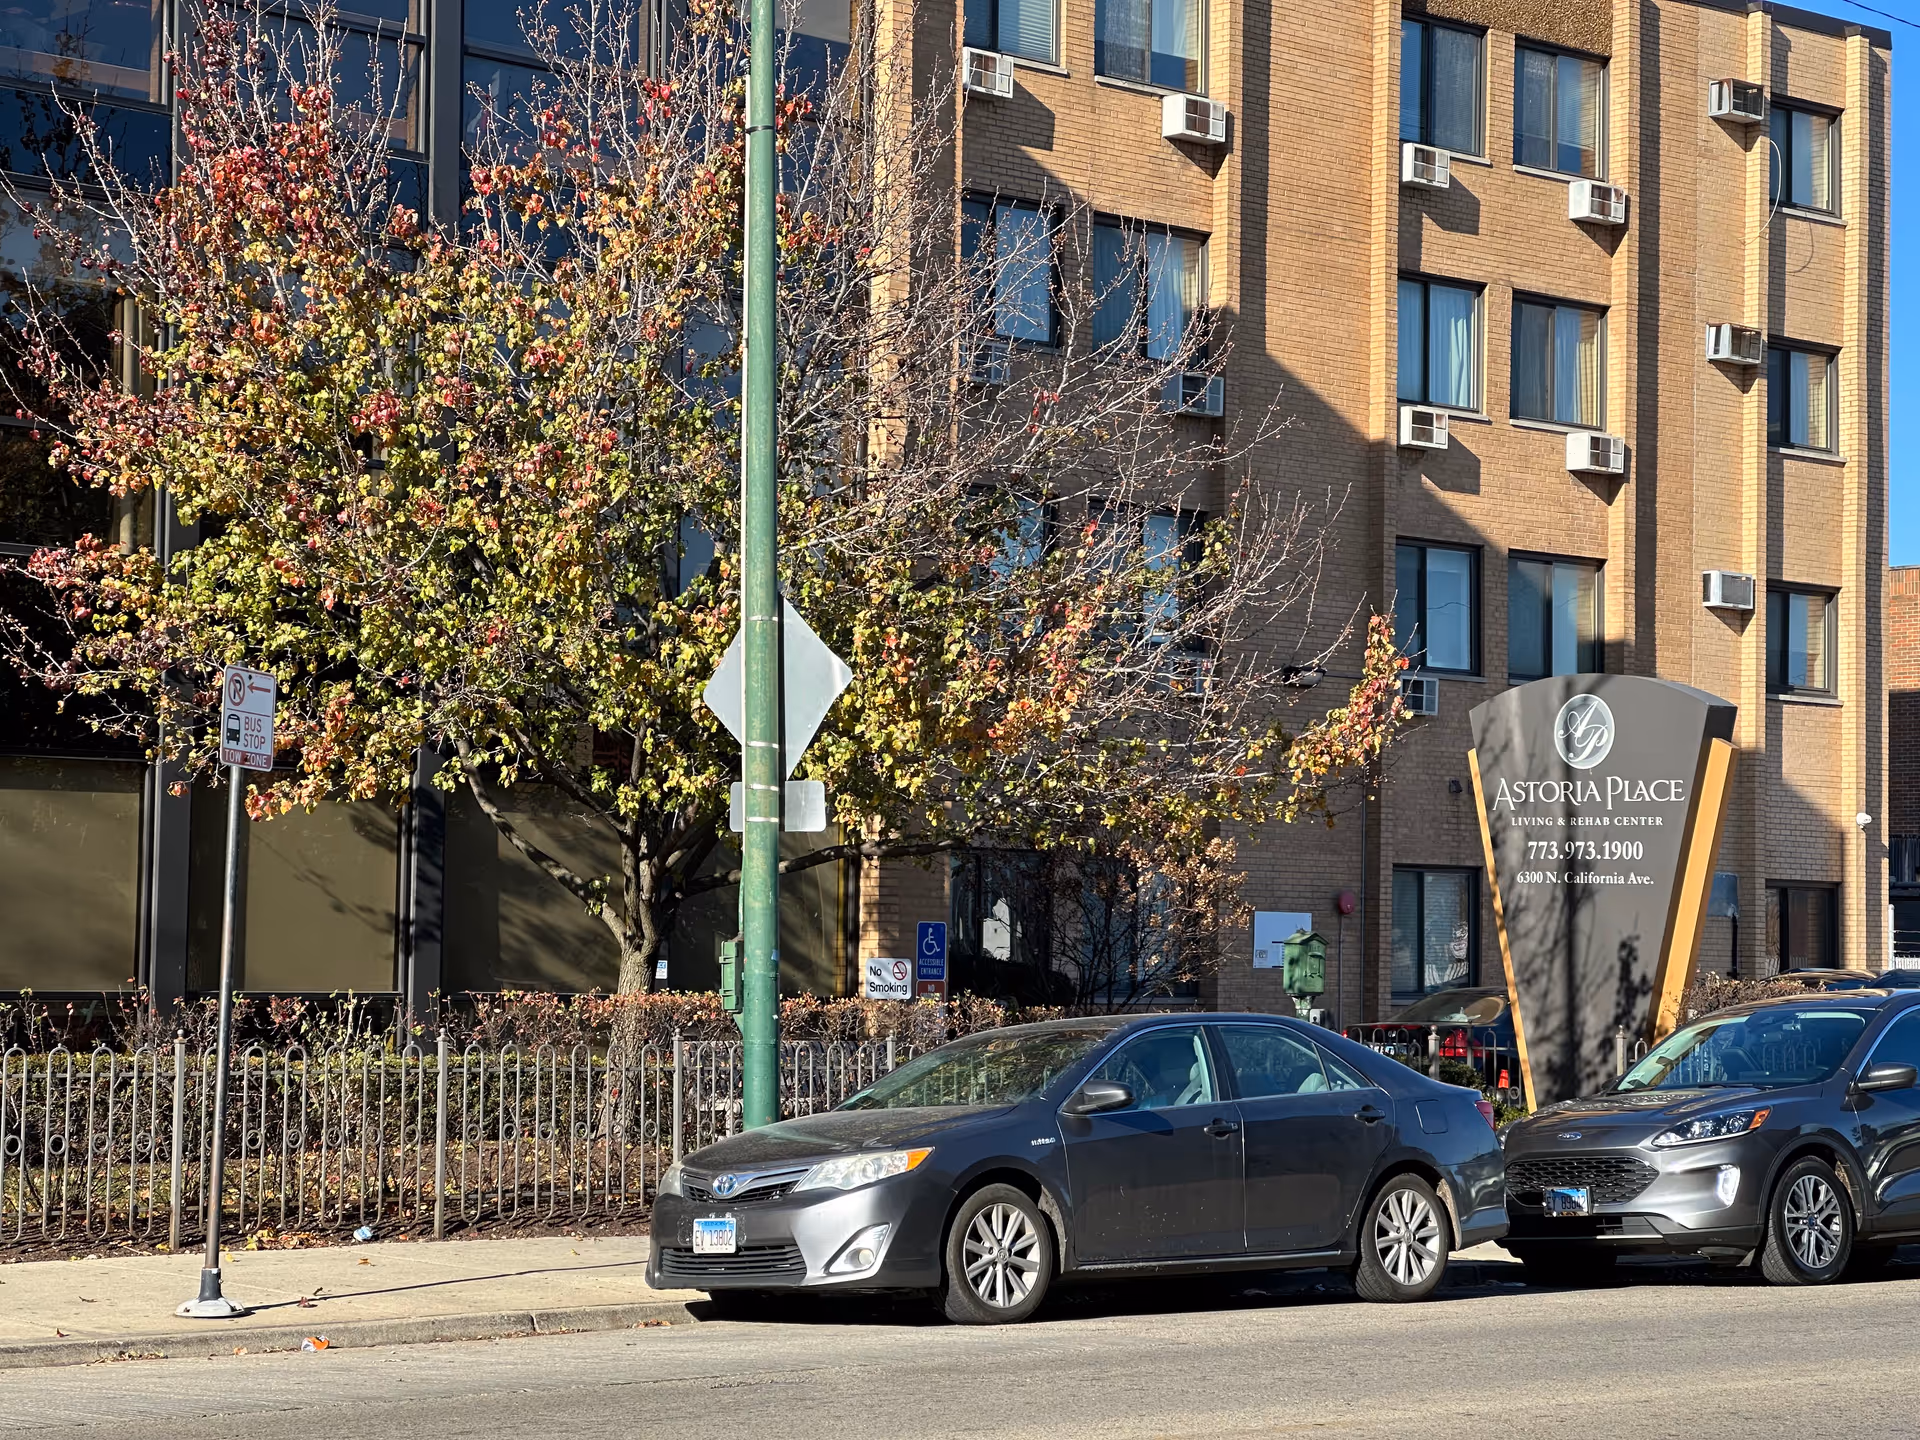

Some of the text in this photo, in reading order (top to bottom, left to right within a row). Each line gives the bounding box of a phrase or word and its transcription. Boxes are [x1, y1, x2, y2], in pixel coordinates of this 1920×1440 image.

[244, 716, 262, 733] BUS
[243, 733, 266, 750] STOP
[225, 749, 242, 762] TOW
[245, 753, 268, 767] ZONE
[1492, 776, 1685, 811] ASTORIA PLACE
[1511, 816, 1664, 826] LIVING & REHAB CENTER
[1527, 841, 1644, 860] 773.973.1900
[1516, 871, 1654, 885] 6300 N. California Ave.
[919, 958, 944, 966] ACCESSIBLE
[869, 966, 882, 976] No
[921, 967, 942, 975] ENTRANCE
[869, 982, 908, 995] Smoking
[709, 1229, 732, 1246] 13802
